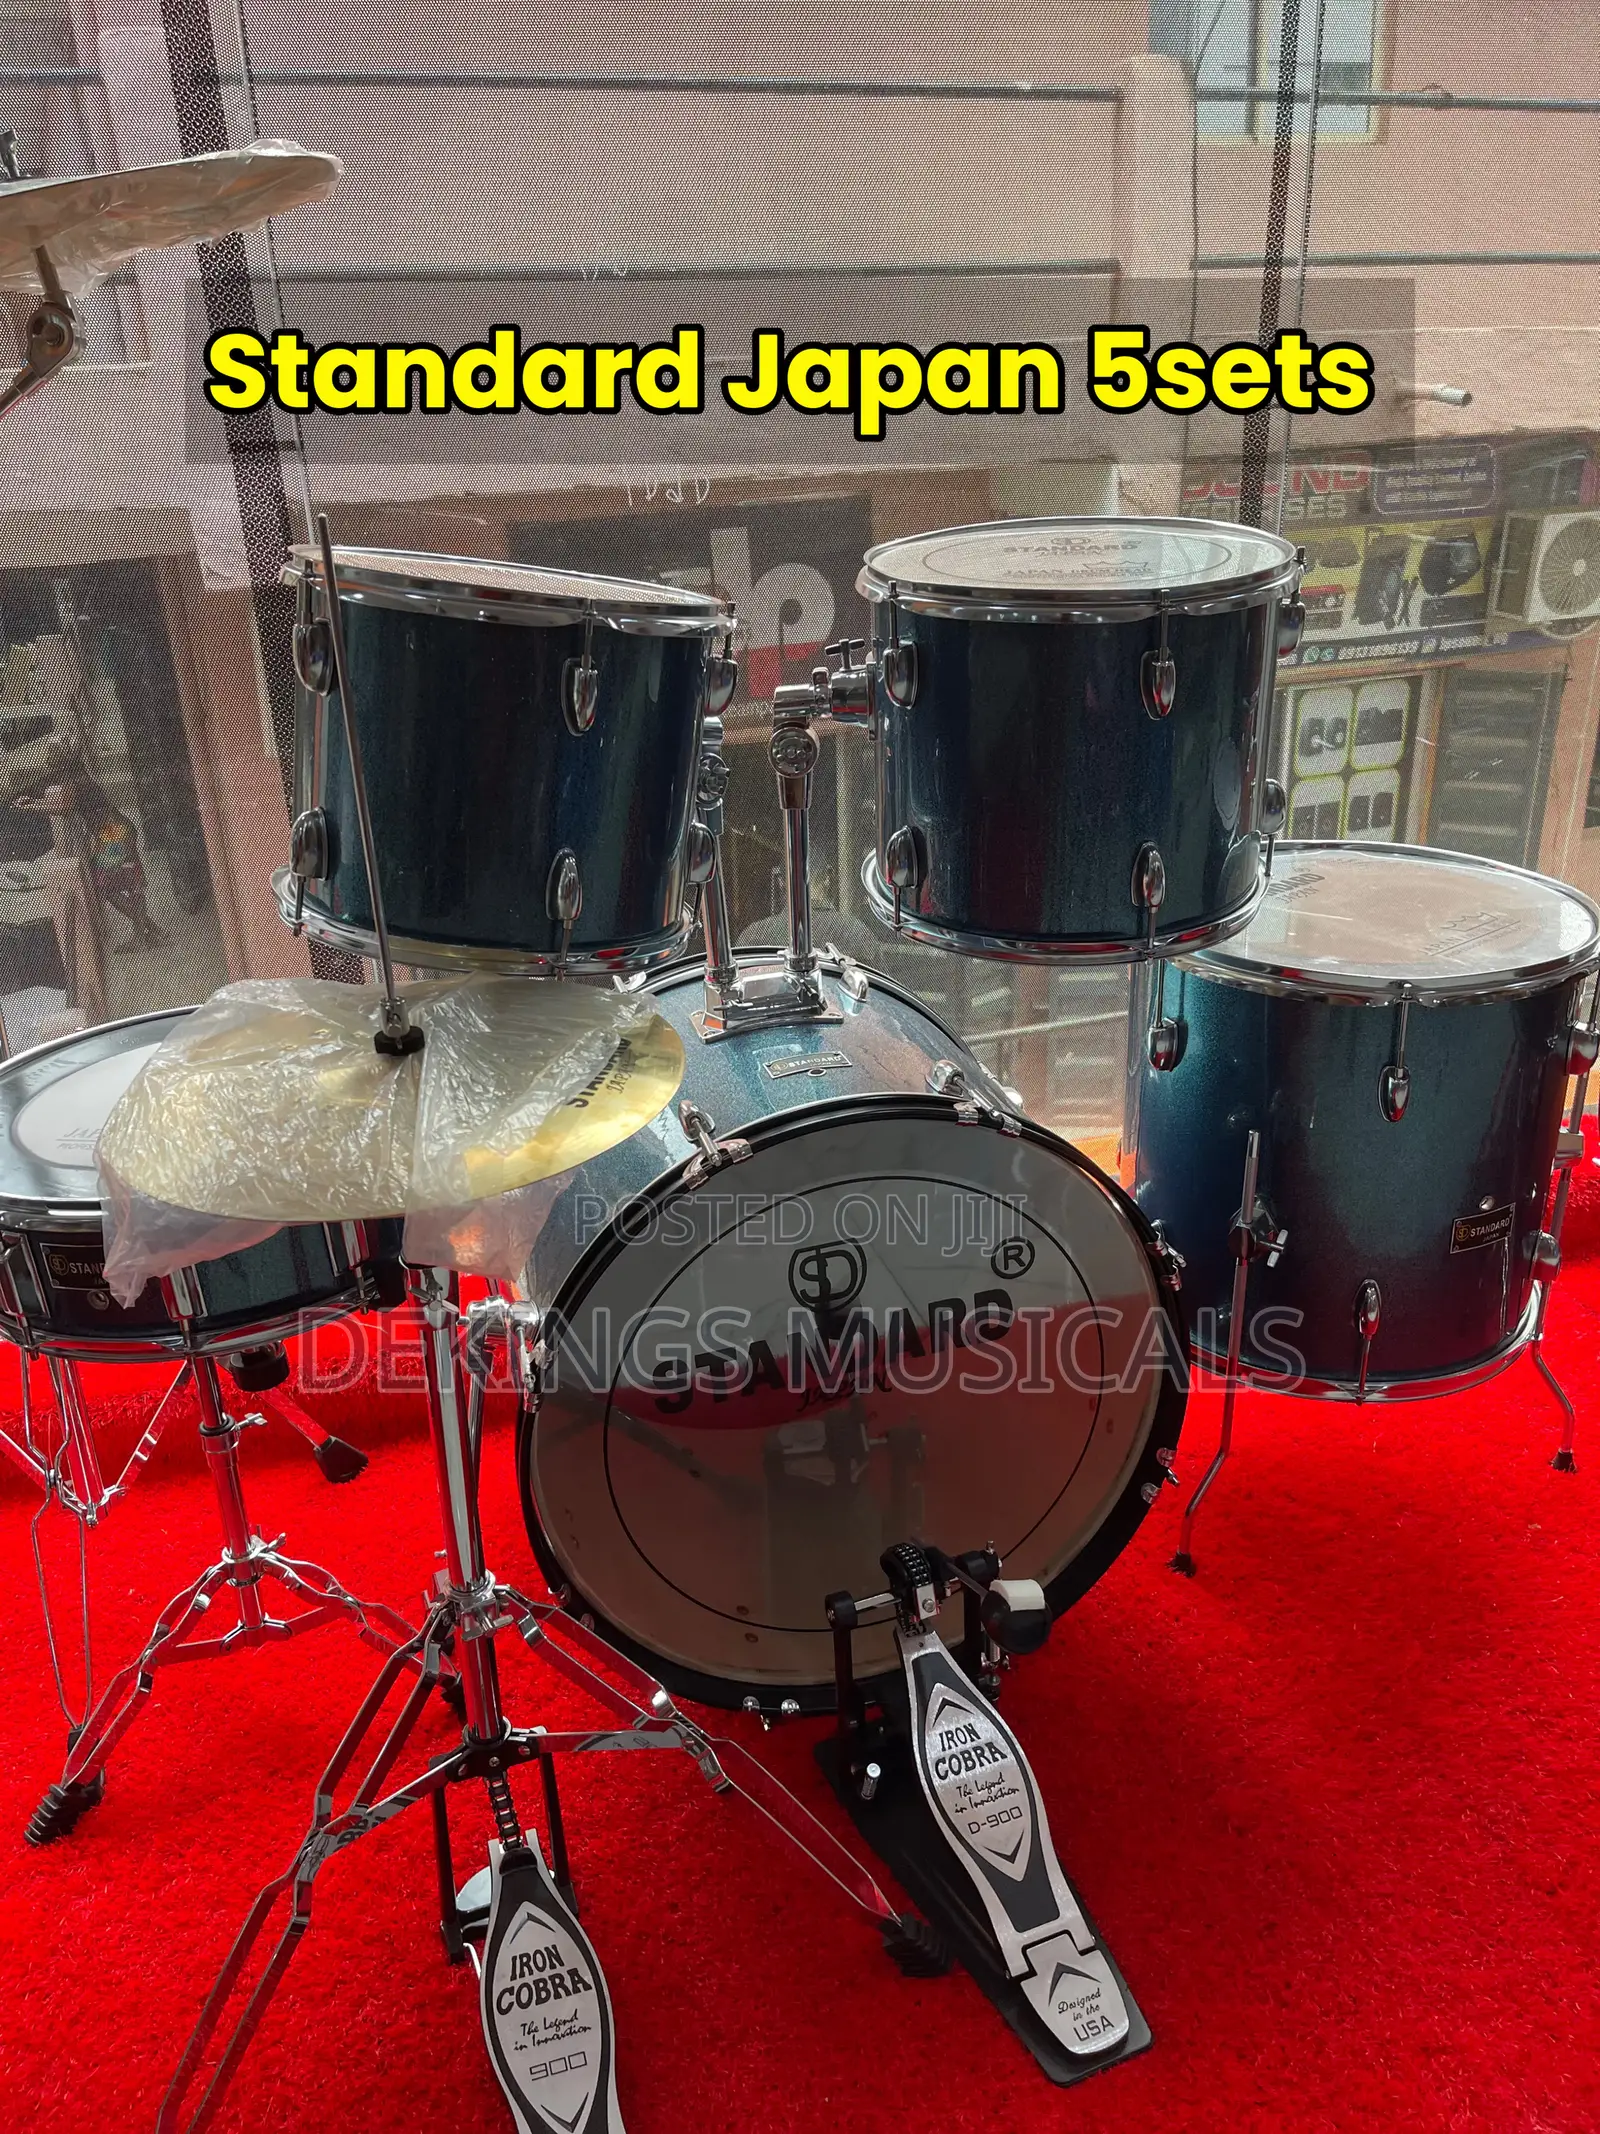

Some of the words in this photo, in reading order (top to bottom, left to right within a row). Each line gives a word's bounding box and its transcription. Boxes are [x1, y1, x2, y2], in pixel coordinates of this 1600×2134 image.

[1004, 544, 1137, 553] STANDARD
[1266, 873, 1325, 896] NDARD
[788, 1055, 842, 1068] STANDARD
[1470, 1218, 1510, 1237] STANDARD
[939, 1722, 981, 1752] IRON
[935, 1741, 1008, 1781] COBRA
[956, 1786, 973, 1798] The
[975, 1772, 1005, 1794] Legend
[955, 1803, 968, 1814] in
[968, 1806, 1023, 1835] D-900
[510, 1944, 564, 1982] IRON
[496, 1967, 593, 2016] COBRA
[1057, 1987, 1102, 2014] Designed
[520, 2022, 540, 2038] The
[543, 2008, 579, 2033] Legend
[1073, 2012, 1083, 2022] in
[1086, 2003, 1100, 2016] the
[1073, 2015, 1115, 2042] USA
[513, 2041, 528, 2051] in
[529, 2051, 588, 2082] 900
